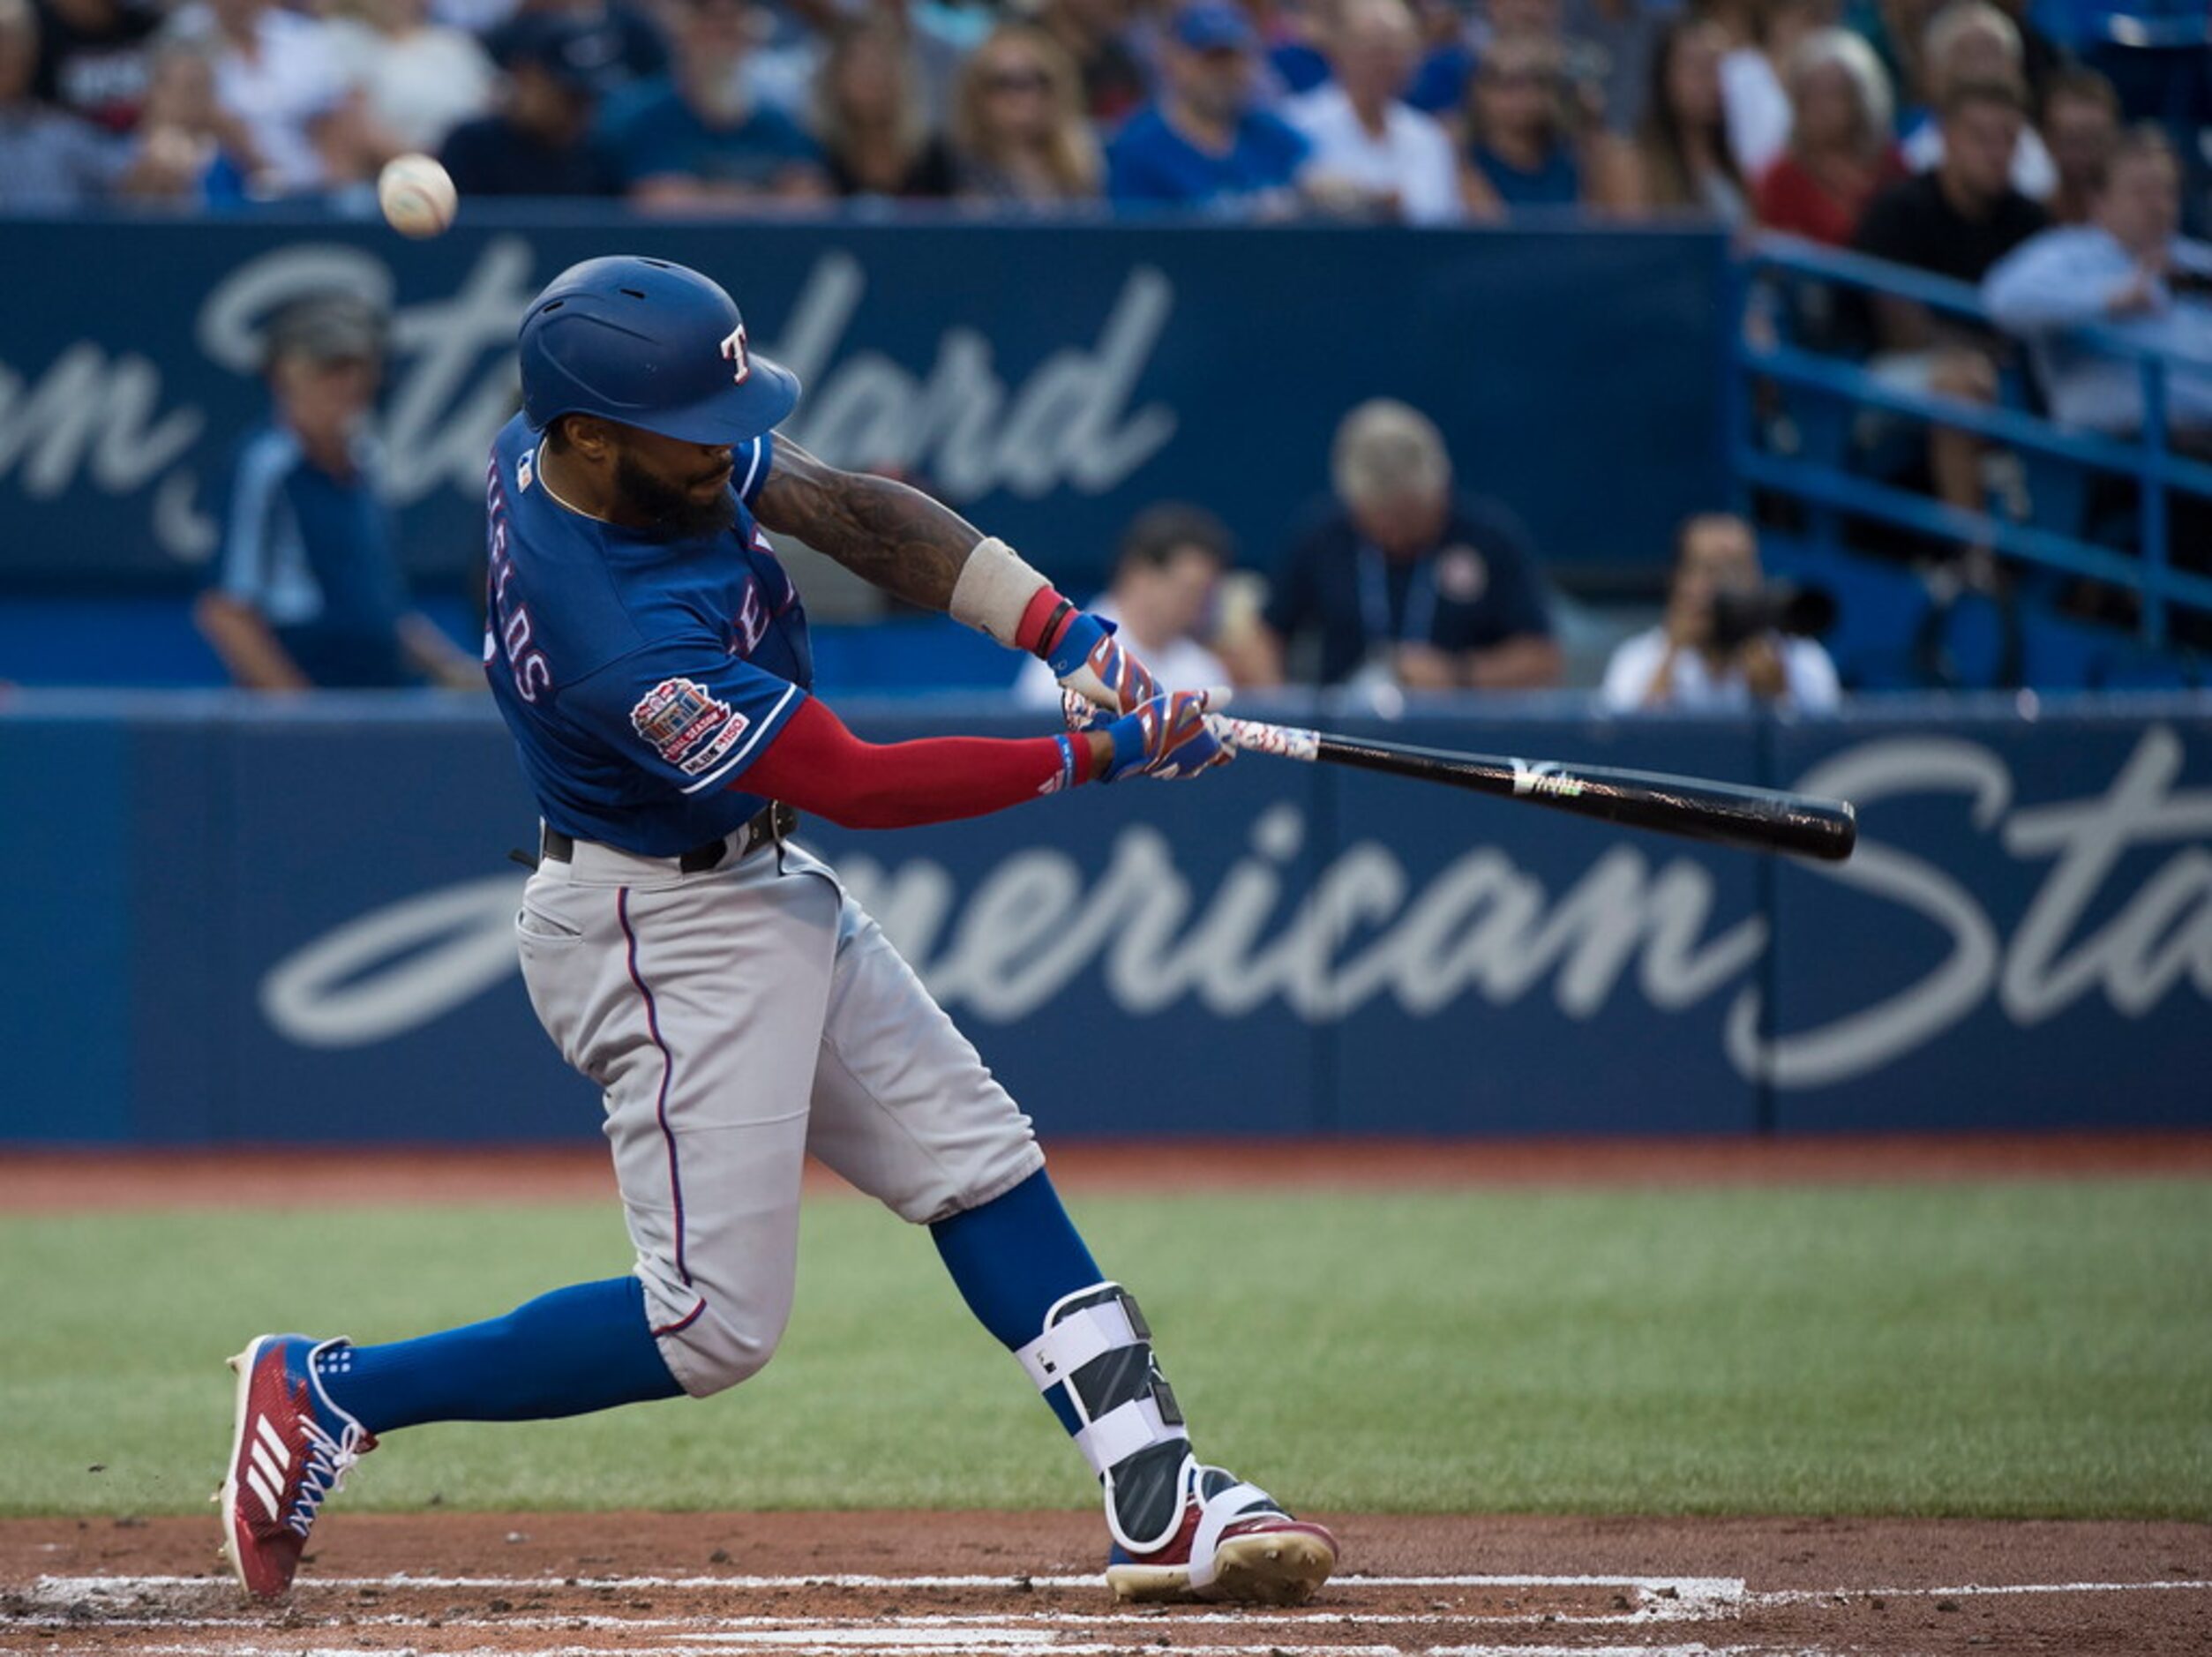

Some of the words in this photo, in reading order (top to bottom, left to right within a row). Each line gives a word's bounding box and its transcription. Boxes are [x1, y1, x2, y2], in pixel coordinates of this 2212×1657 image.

[719, 322, 753, 386] T
[685, 754, 712, 773] MLB
[262, 805, 1765, 1047] merican
